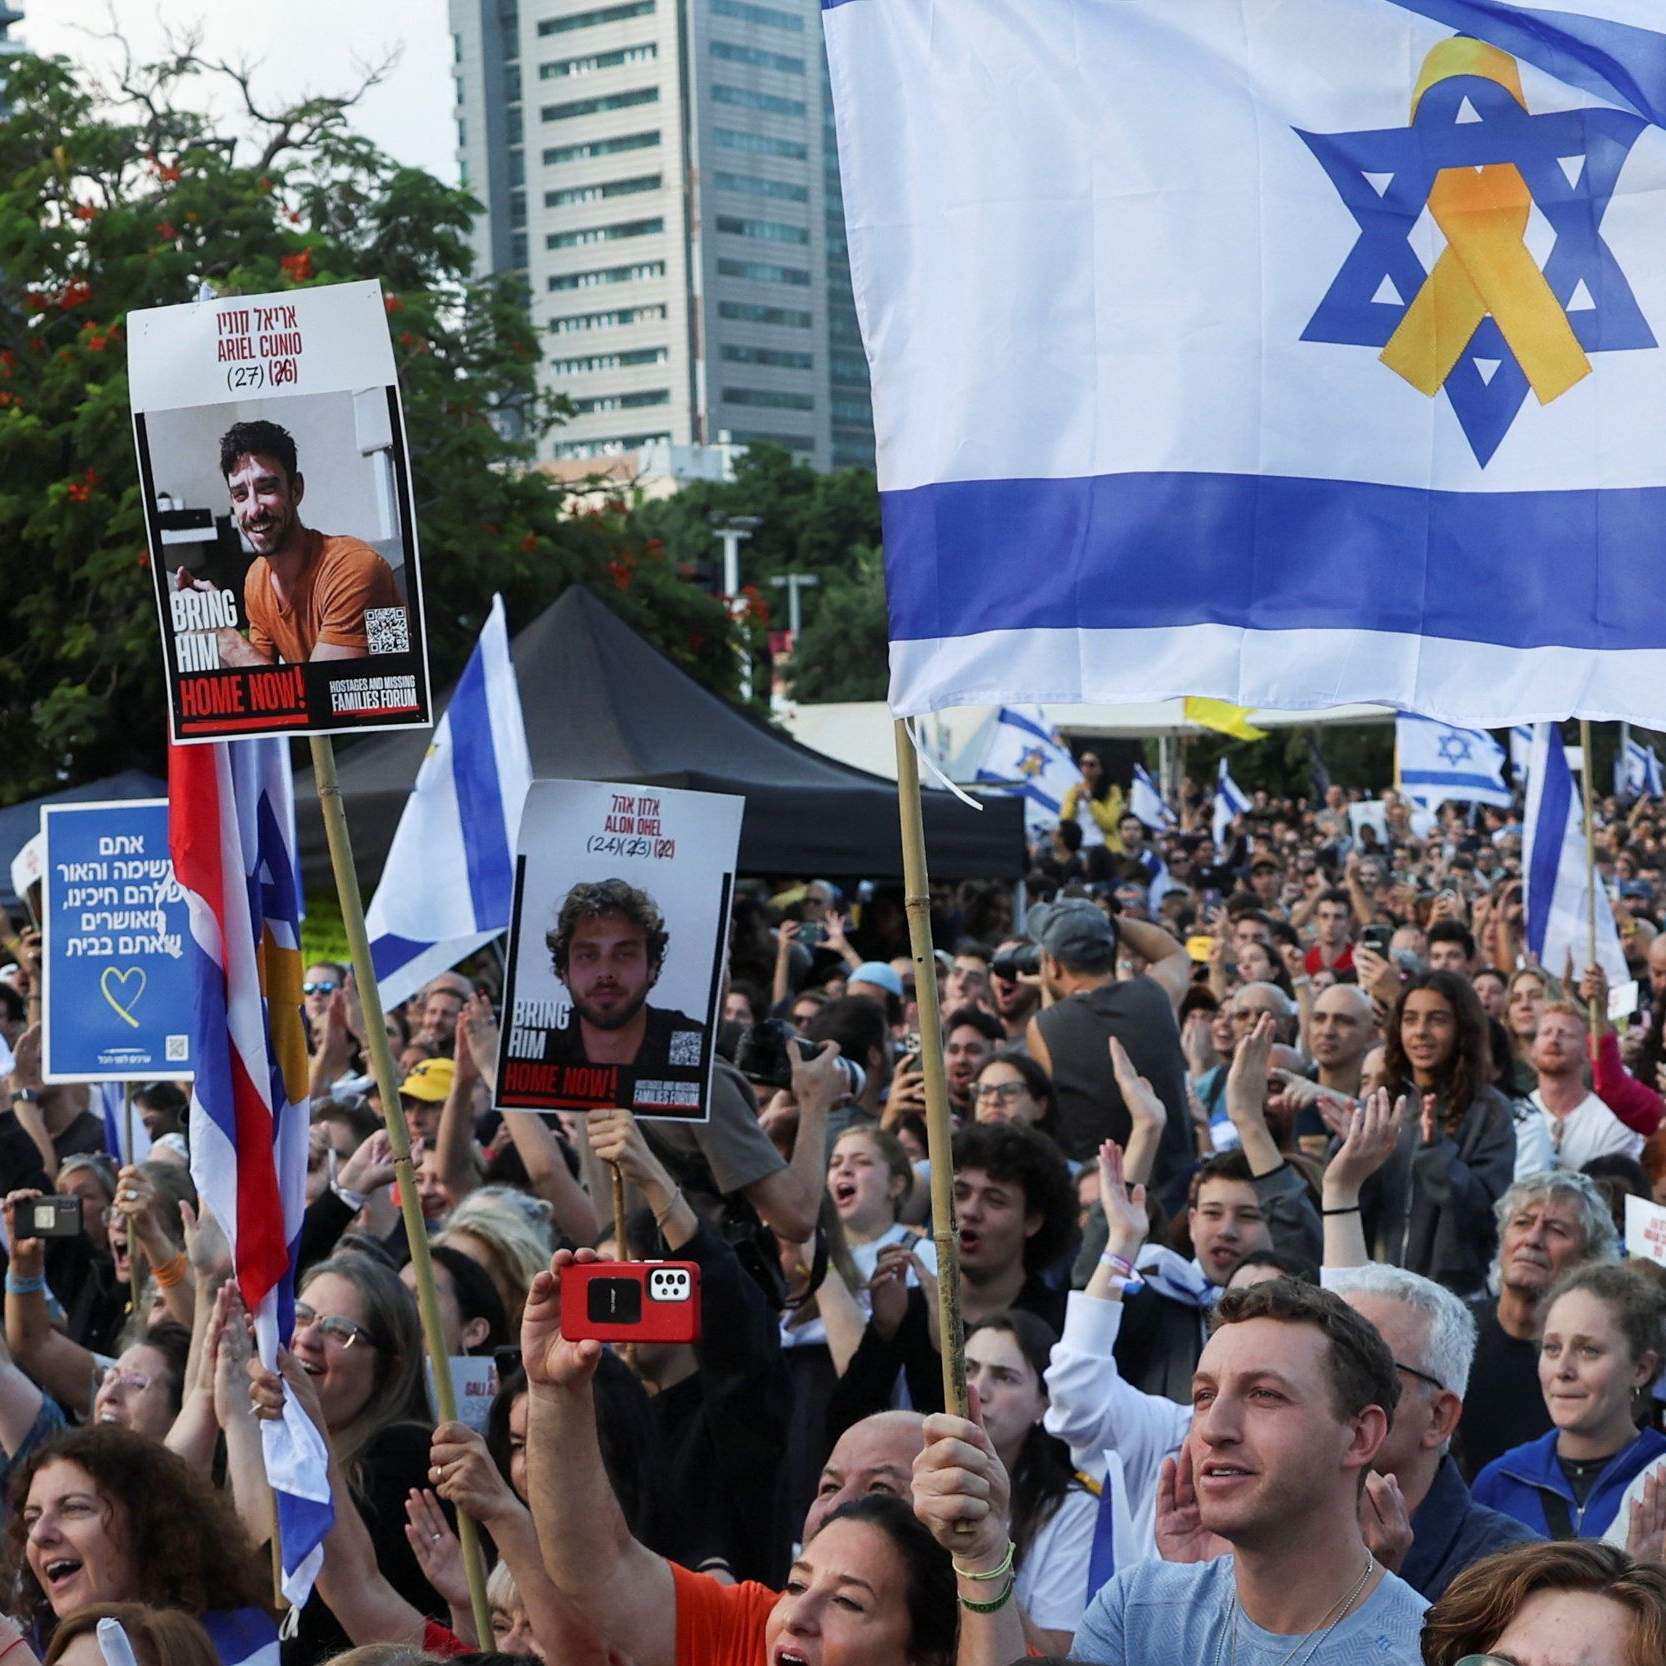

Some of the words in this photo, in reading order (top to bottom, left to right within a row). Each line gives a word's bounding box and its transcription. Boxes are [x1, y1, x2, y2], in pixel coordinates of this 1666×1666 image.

[216, 308, 251, 337] קוניו
[253, 304, 298, 333] אריאל
[217, 334, 258, 363] ARIEL
[259, 332, 303, 359] CUNIO
[171, 588, 238, 632] BRING
[176, 631, 220, 673] HIM
[178, 676, 245, 717] HOME
[249, 665, 307, 712] NOW!
[329, 678, 369, 693] HOSTAGES
[369, 677, 383, 690] AND
[383, 675, 416, 690] MISSING
[331, 690, 380, 712] FAMILIES
[381, 688, 418, 710] FORUM
[611, 794, 636, 815] אהל
[637, 797, 661, 818] אלון
[605, 815, 634, 835] ALON
[636, 817, 662, 837] OHEL
[99, 835, 144, 856] אתם
[57, 862, 107, 882] והאור
[62, 886, 118, 911] חיכינו,
[81, 910, 166, 931] מאושרים
[66, 936, 113, 956] בבית
[513, 1000, 571, 1031] BRING
[507, 1030, 547, 1060] HIM
[504, 1062, 557, 1094] HOME
[564, 1066, 619, 1100] NOW!
